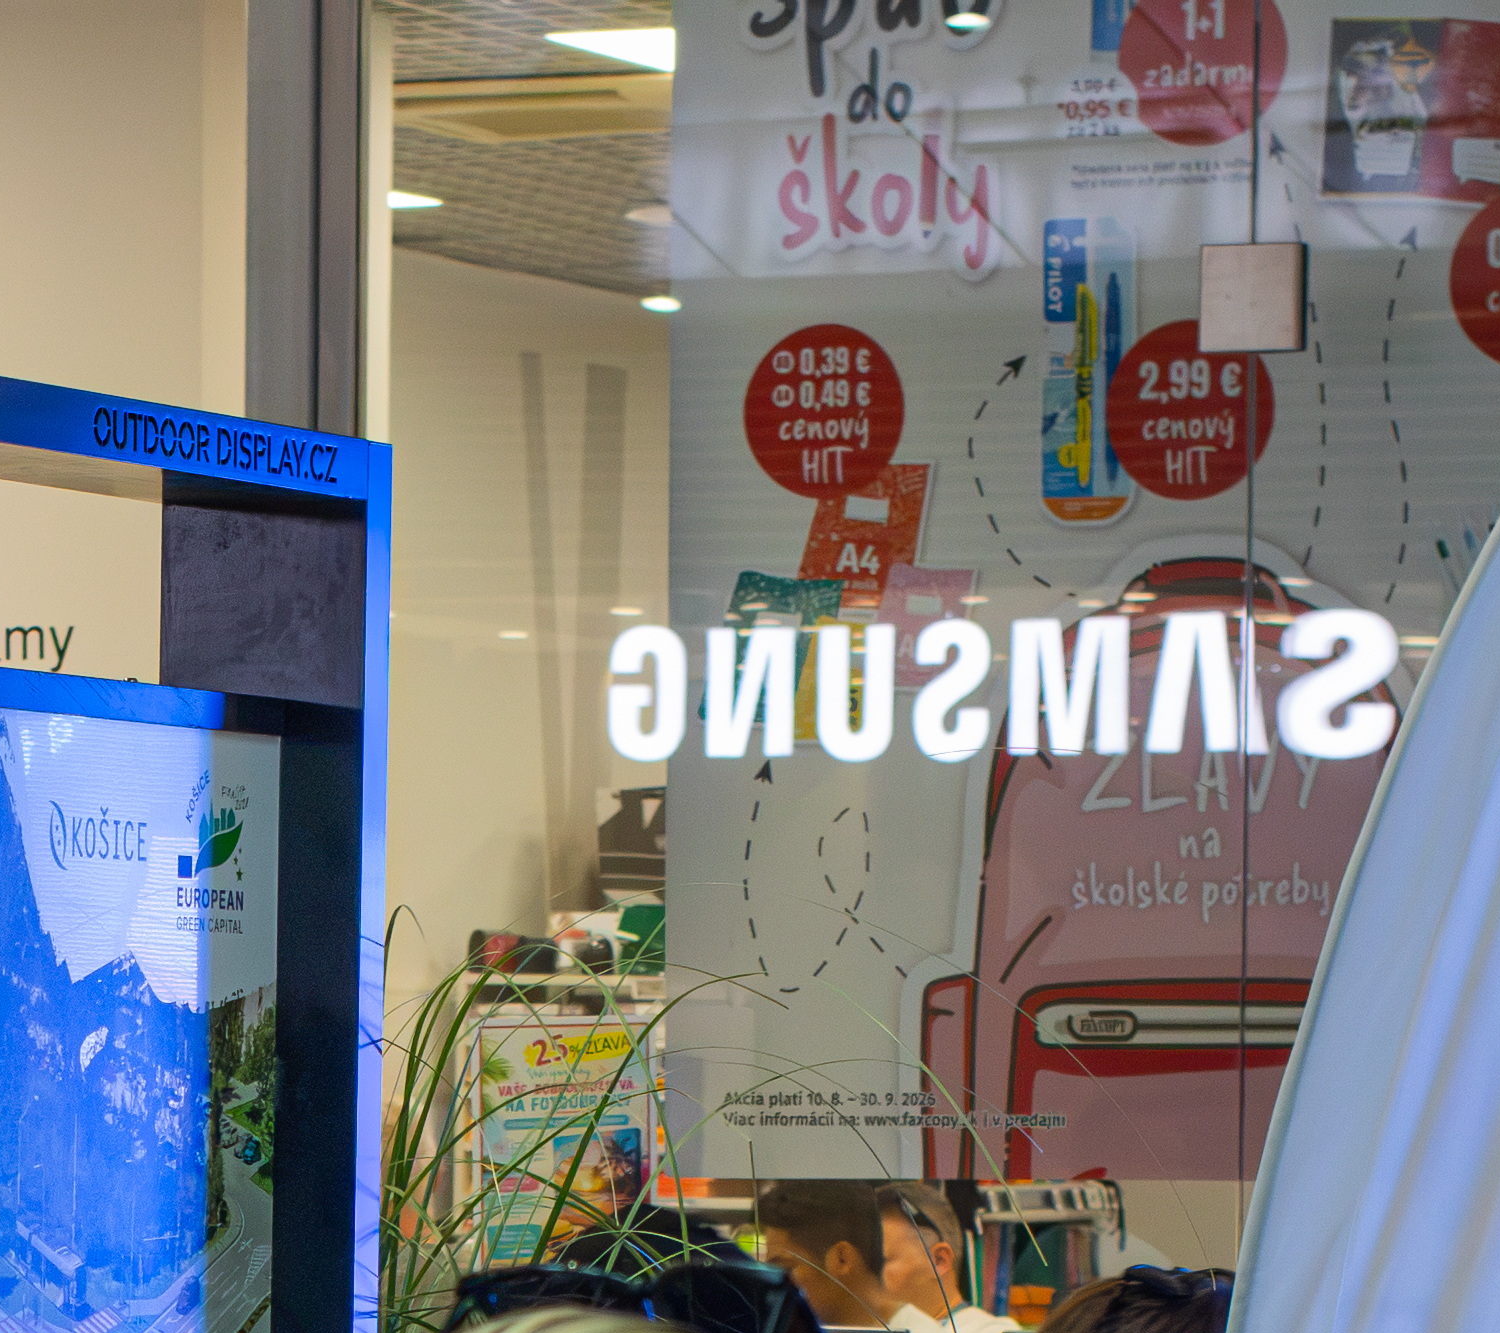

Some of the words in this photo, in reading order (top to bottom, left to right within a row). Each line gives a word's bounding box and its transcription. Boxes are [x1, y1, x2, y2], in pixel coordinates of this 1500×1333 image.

[848, 47, 913, 124] do
[778, 113, 989, 269] školy
[799, 347, 849, 378] 0,39
[855, 348, 871, 373] €
[1138, 359, 1211, 404] 2,99
[1220, 361, 1242, 397] €
[94, 407, 211, 463] OUTDOOR
[217, 427, 339, 484] DISPLAY.CZ
[778, 409, 869, 448] cenový
[1142, 409, 1235, 449] cenový
[801, 445, 854, 484] HIT
[1165, 446, 1218, 485] HIT
[836, 543, 881, 575] A4
[72, 807, 148, 862] KOŠICE
[1178, 827, 1222, 859] na
[176, 886, 244, 912] EUROPEAN
[1072, 860, 1189, 910] školské
[176, 916, 205, 932] GREEN
[208, 916, 244, 935] CAPITAL
[769, 1091, 802, 1109] platí
